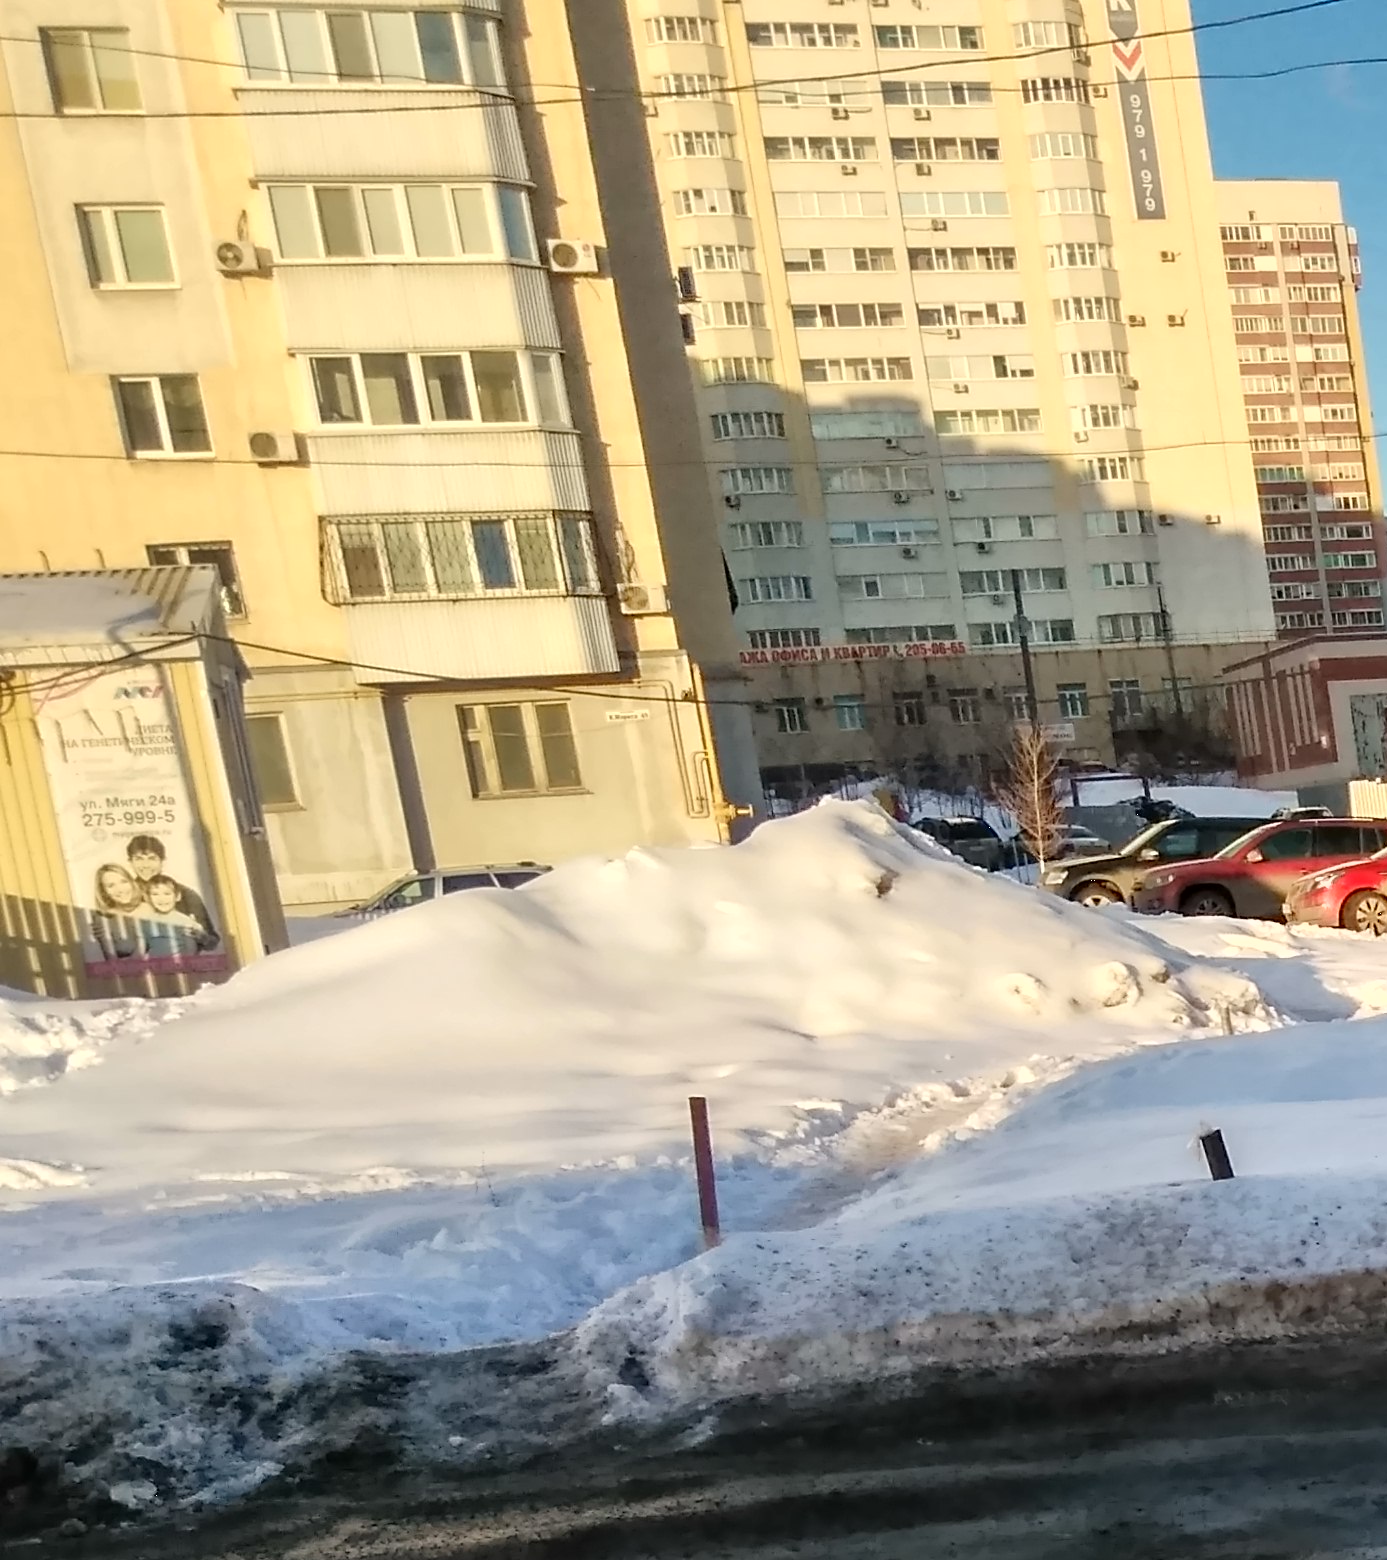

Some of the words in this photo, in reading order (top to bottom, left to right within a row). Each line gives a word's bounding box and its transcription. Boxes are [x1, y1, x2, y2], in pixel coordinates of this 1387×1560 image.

[1130, 94, 1145, 138] 979
[1140, 169, 1156, 212] 979
[771, 648, 818, 664] ОФИСА
[834, 645, 890, 661] КВАРТИР
[80, 800, 102, 812] ул.
[106, 797, 146, 808] Мяги
[149, 795, 176, 806] 24а
[82, 809, 176, 827] 275-999-5
